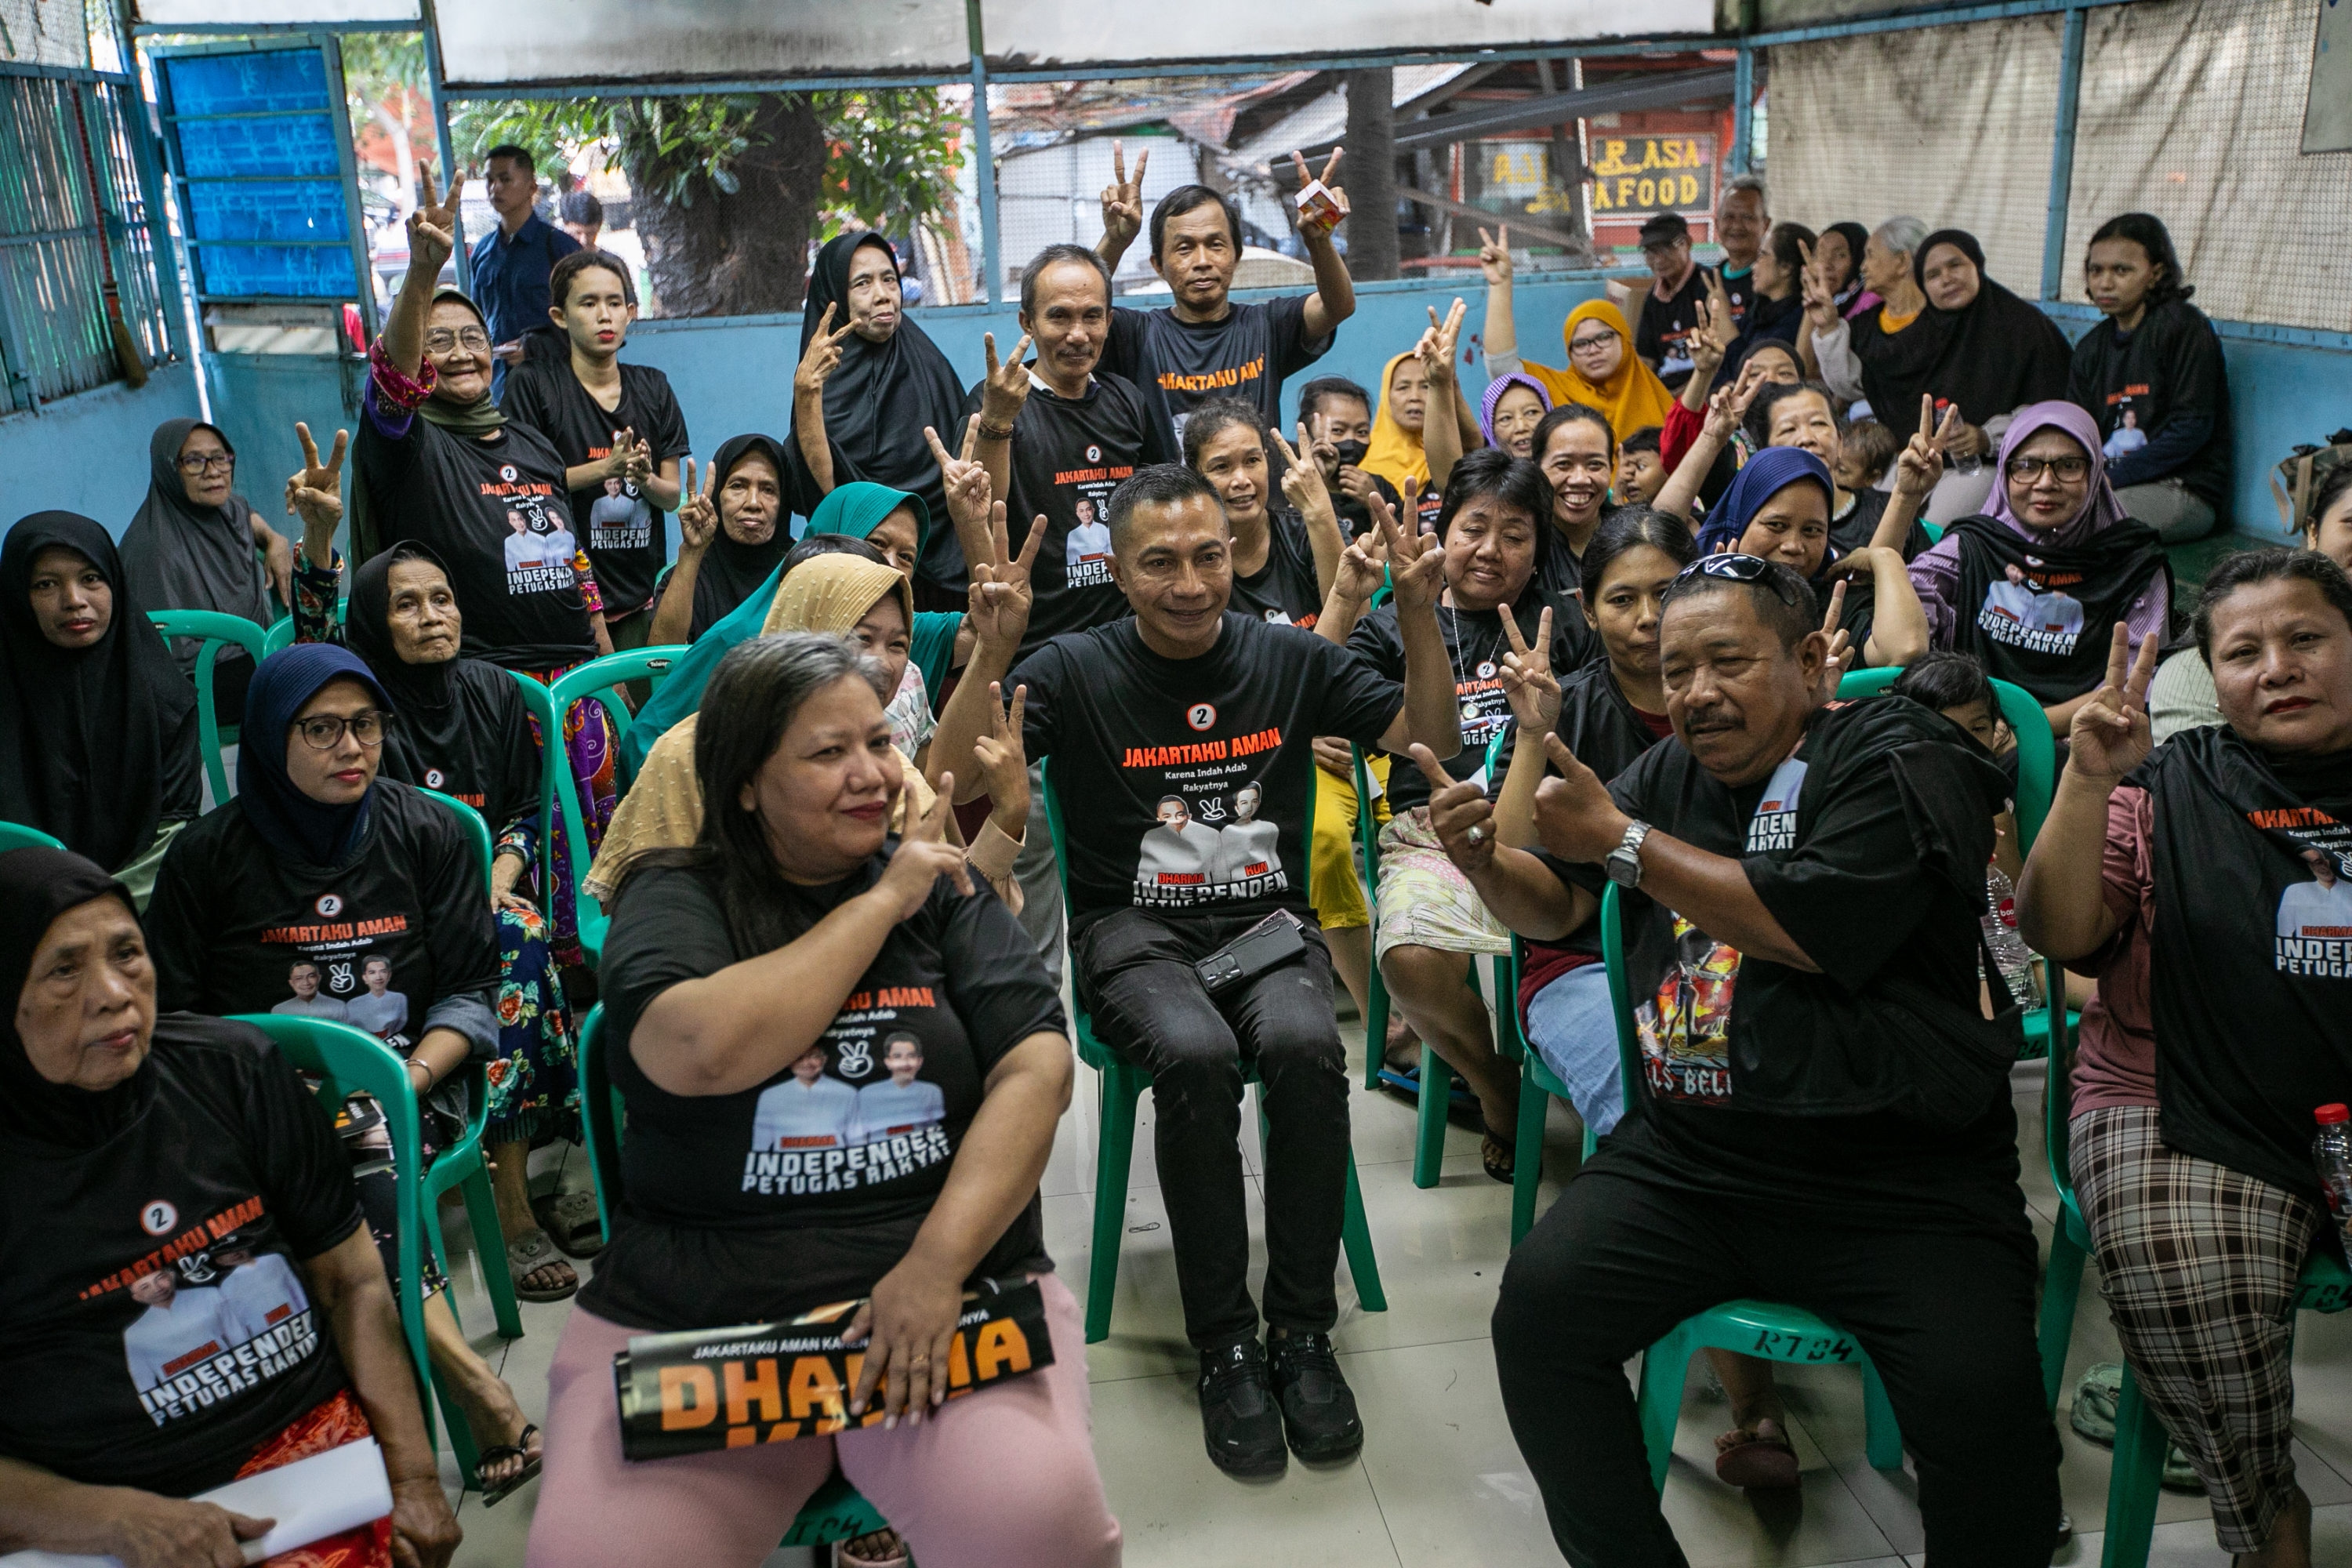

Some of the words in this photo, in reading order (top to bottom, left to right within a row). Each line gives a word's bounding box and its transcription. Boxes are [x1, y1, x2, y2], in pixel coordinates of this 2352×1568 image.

[1091, 448, 1097, 459] 2
[505, 470, 512, 478] 2
[1054, 468, 1107, 485] JAKARTAKU
[1109, 466, 1133, 479] AMAN
[509, 580, 556, 595] PETUGAS
[2024, 637, 2075, 656] RAKYAT
[1483, 665, 1490, 675] 2
[1196, 708, 1207, 725] 2
[1122, 740, 1228, 768] JAKARTAKU
[1232, 728, 1283, 757] AMAN
[430, 773, 437, 784] 2
[1165, 770, 1196, 780] Karena
[1196, 767, 1223, 778] Indah
[1224, 762, 1248, 774] Adab
[1182, 780, 1229, 793] Rakyatnya
[2321, 825, 2351, 837] Indah
[1746, 833, 1797, 852] AKYAT
[1244, 861, 1269, 877] KUN
[1132, 870, 1290, 900] INDEPENDEN
[1157, 872, 1206, 885] DHARMA
[324, 898, 335, 913] 2
[261, 923, 354, 943] JAKARTAKU
[357, 915, 407, 937] AMAN
[2302, 925, 2352, 938] DHARMA
[325, 942, 352, 951] Indah
[351, 937, 374, 947] Adab
[314, 952, 357, 962] Rakyatnya
[877, 986, 936, 1008] AMAN
[867, 1008, 898, 1021] Adab
[741, 1169, 859, 1196] PETUGAS
[866, 1138, 952, 1185] RAKYAT
[151, 1207, 168, 1230] 2
[692, 1339, 778, 1359] JAKARTAKU
[779, 1337, 820, 1353] AMAN
[149, 1366, 260, 1429] PETUGAS
